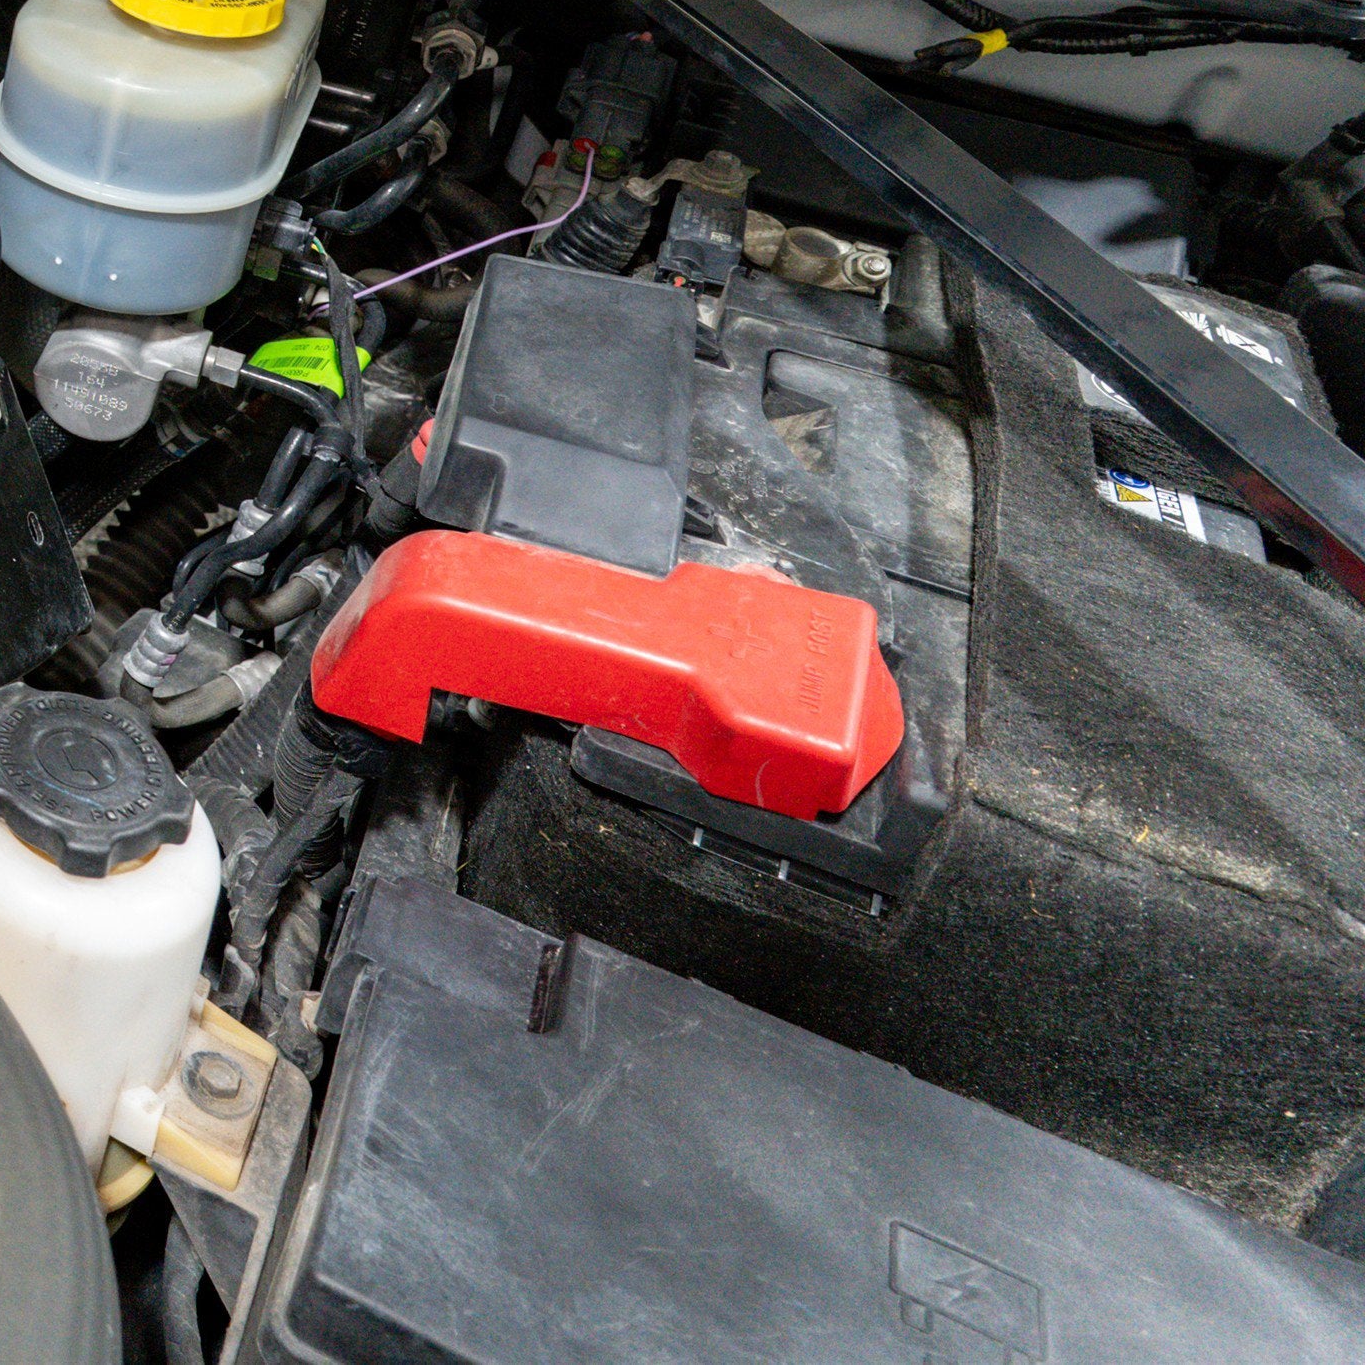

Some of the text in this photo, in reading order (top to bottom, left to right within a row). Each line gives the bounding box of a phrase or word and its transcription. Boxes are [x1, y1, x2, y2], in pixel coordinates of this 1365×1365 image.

[78, 371, 105, 388] 164
[798, 606, 833, 714] JUMP POST
[34, 697, 93, 717] FLUID
[102, 710, 164, 788] STEERING
[31, 792, 72, 818] USE
[90, 790, 158, 824] POWER
